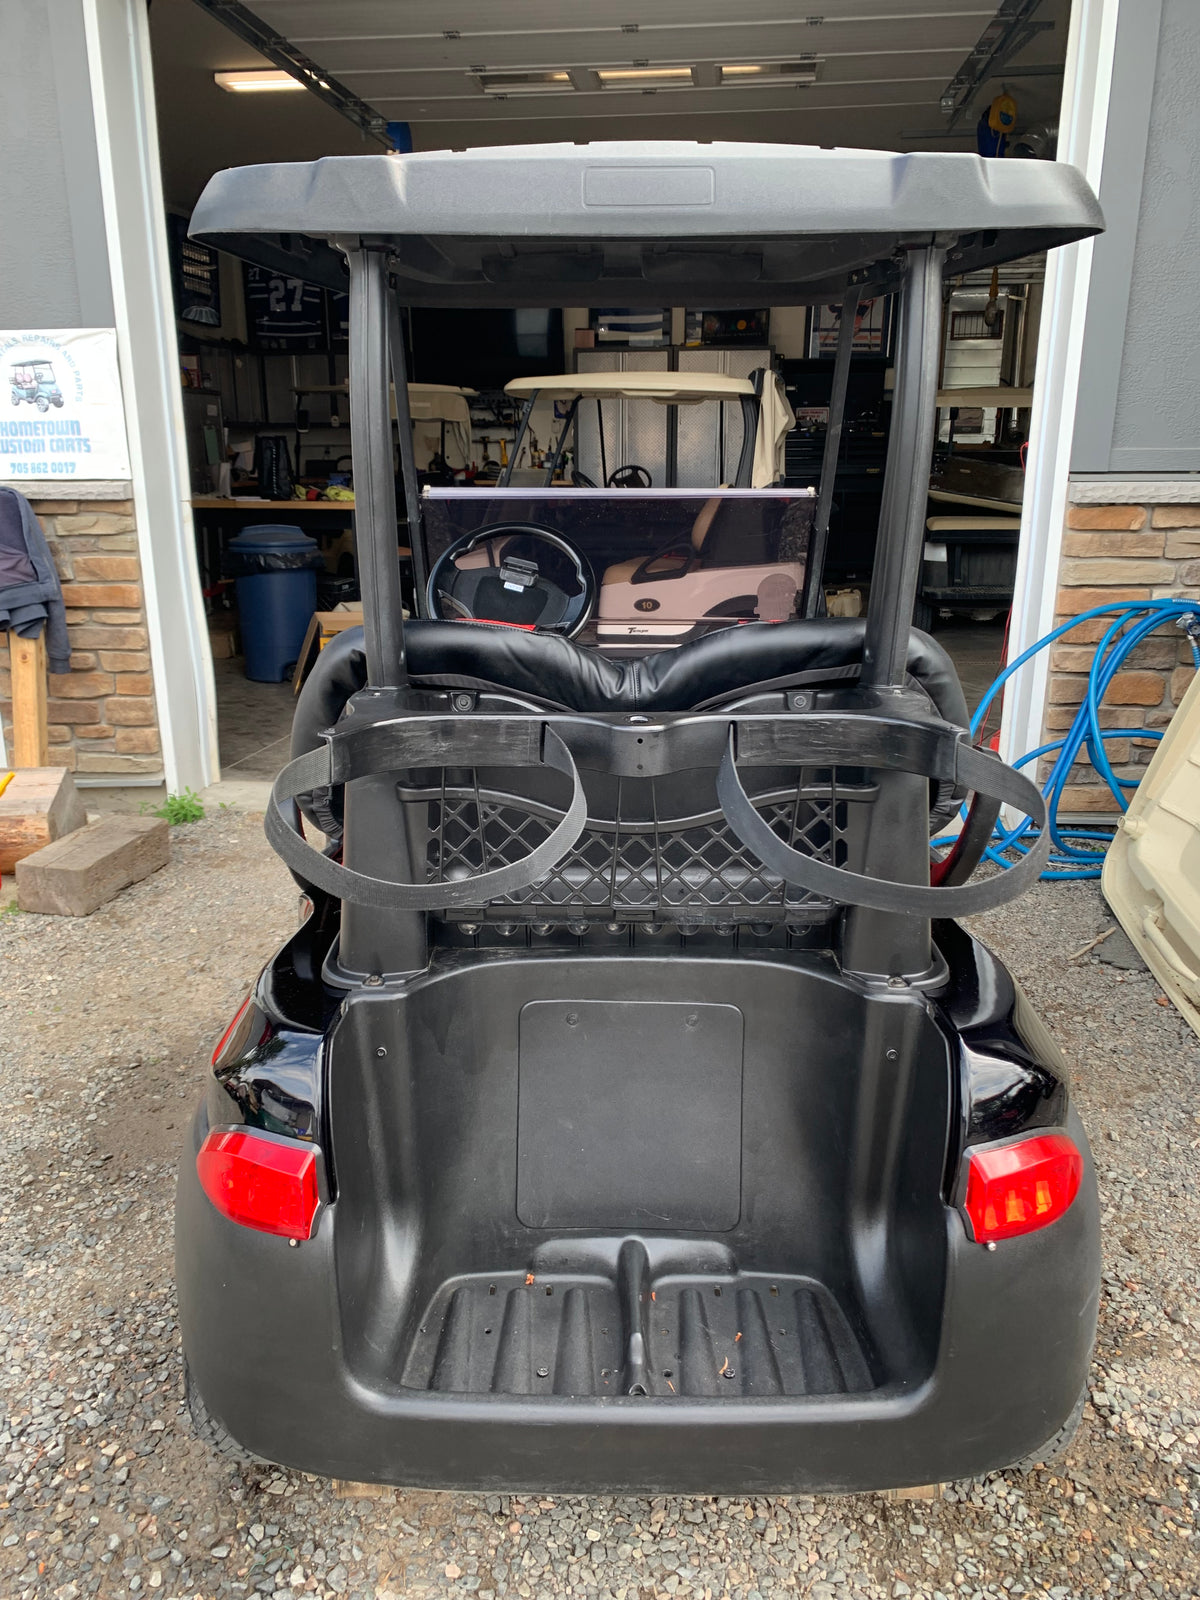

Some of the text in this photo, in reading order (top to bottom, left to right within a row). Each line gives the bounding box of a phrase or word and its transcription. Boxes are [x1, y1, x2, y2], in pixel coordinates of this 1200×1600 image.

[269, 279, 303, 312] 27
[22, 334, 60, 350] REPAIRS
[62, 350, 76, 368] AND
[74, 370, 84, 402] PARTS
[0, 420, 81, 437] HOMETOWN
[49, 437, 91, 454] CARTS
[10, 461, 76, 474] 705 862 0017
[643, 602, 653, 610] 10
